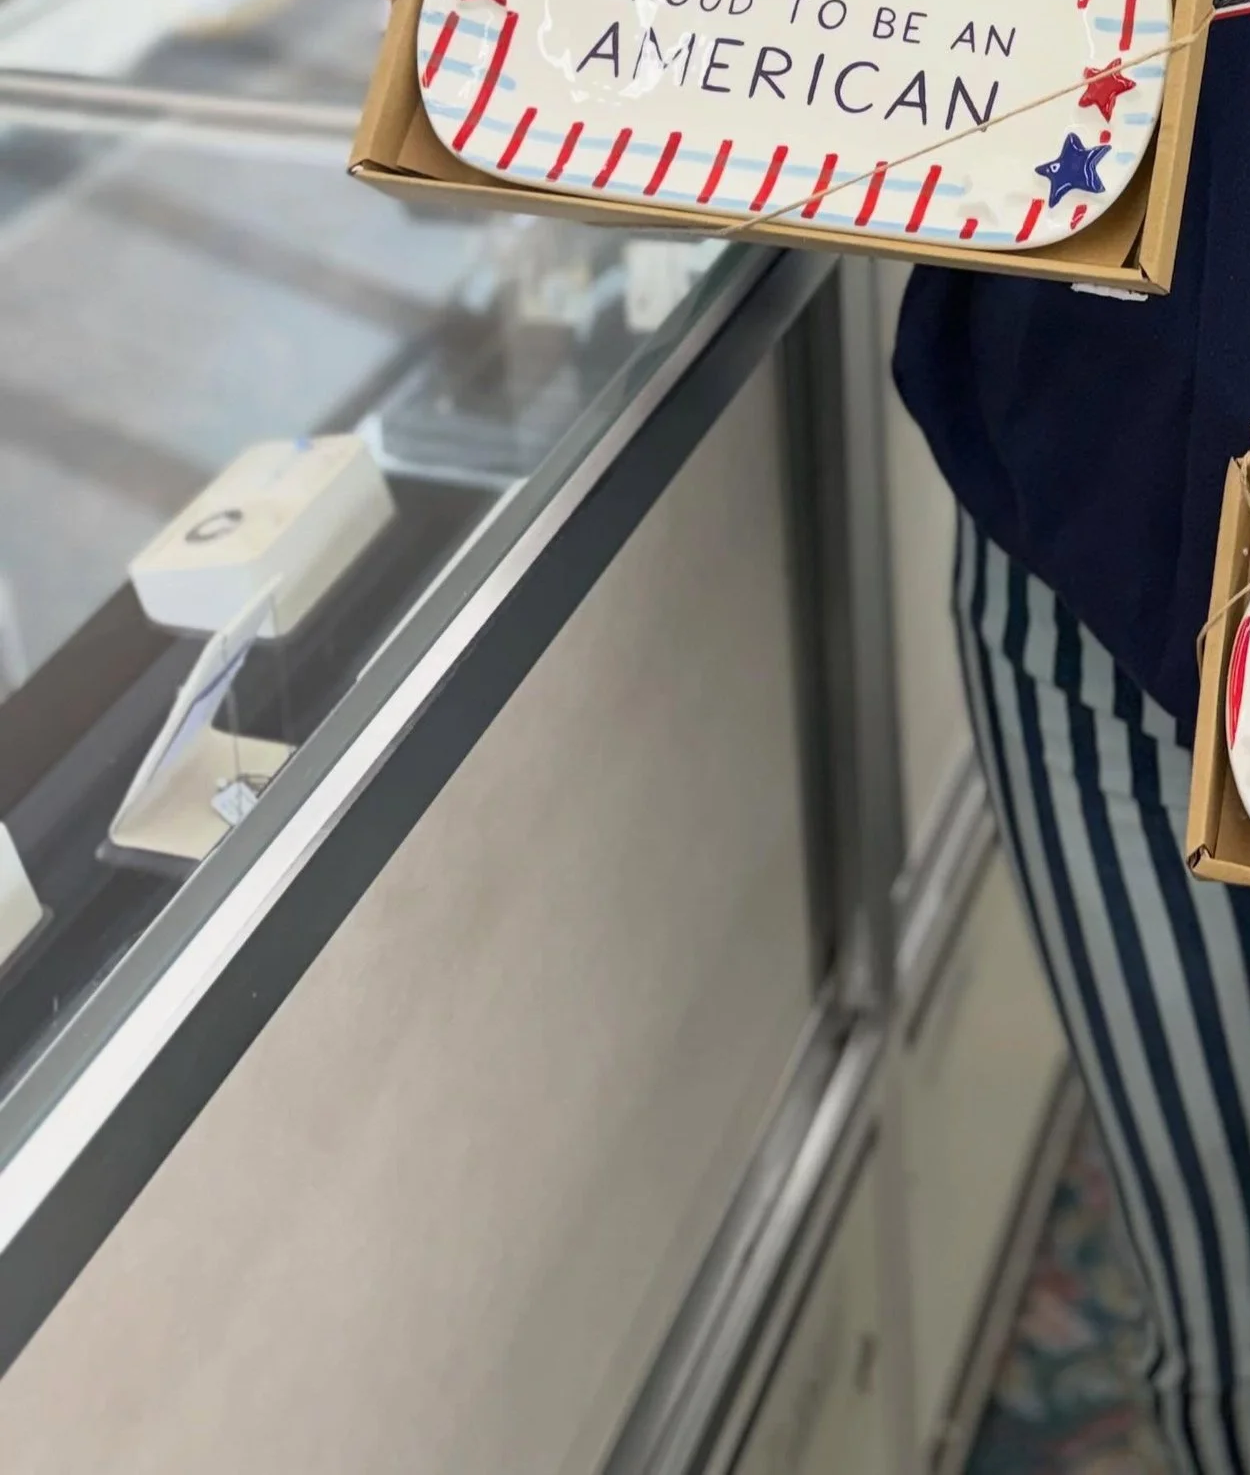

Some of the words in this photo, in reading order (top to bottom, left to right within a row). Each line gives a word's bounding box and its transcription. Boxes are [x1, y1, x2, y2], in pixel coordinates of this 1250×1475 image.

[872, 6, 928, 45] BE
[949, 20, 1016, 58] AN
[575, 20, 999, 133] AMERICAN
